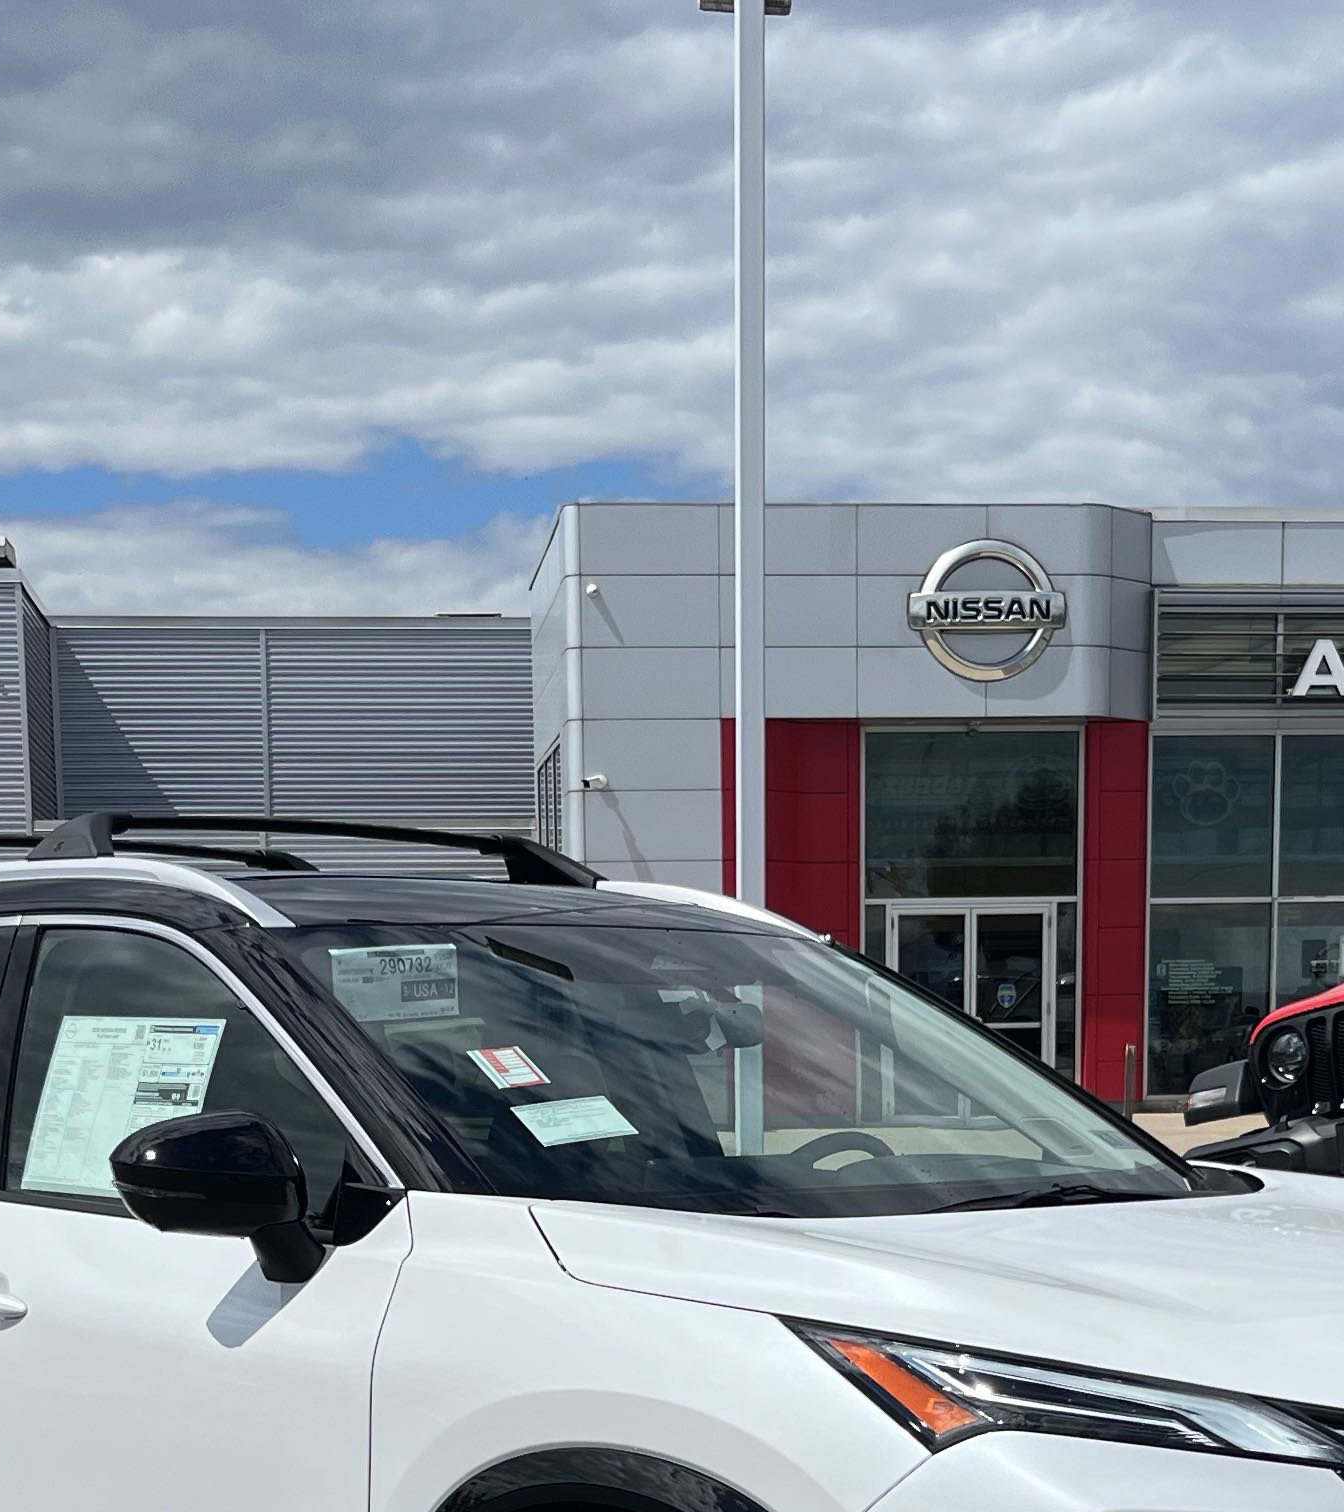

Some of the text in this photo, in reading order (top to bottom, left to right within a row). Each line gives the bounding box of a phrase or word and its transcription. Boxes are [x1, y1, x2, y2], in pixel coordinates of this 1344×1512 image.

[925, 599, 1052, 623] NISSAN
[379, 956, 433, 975] 290732
[413, 983, 438, 998] USA
